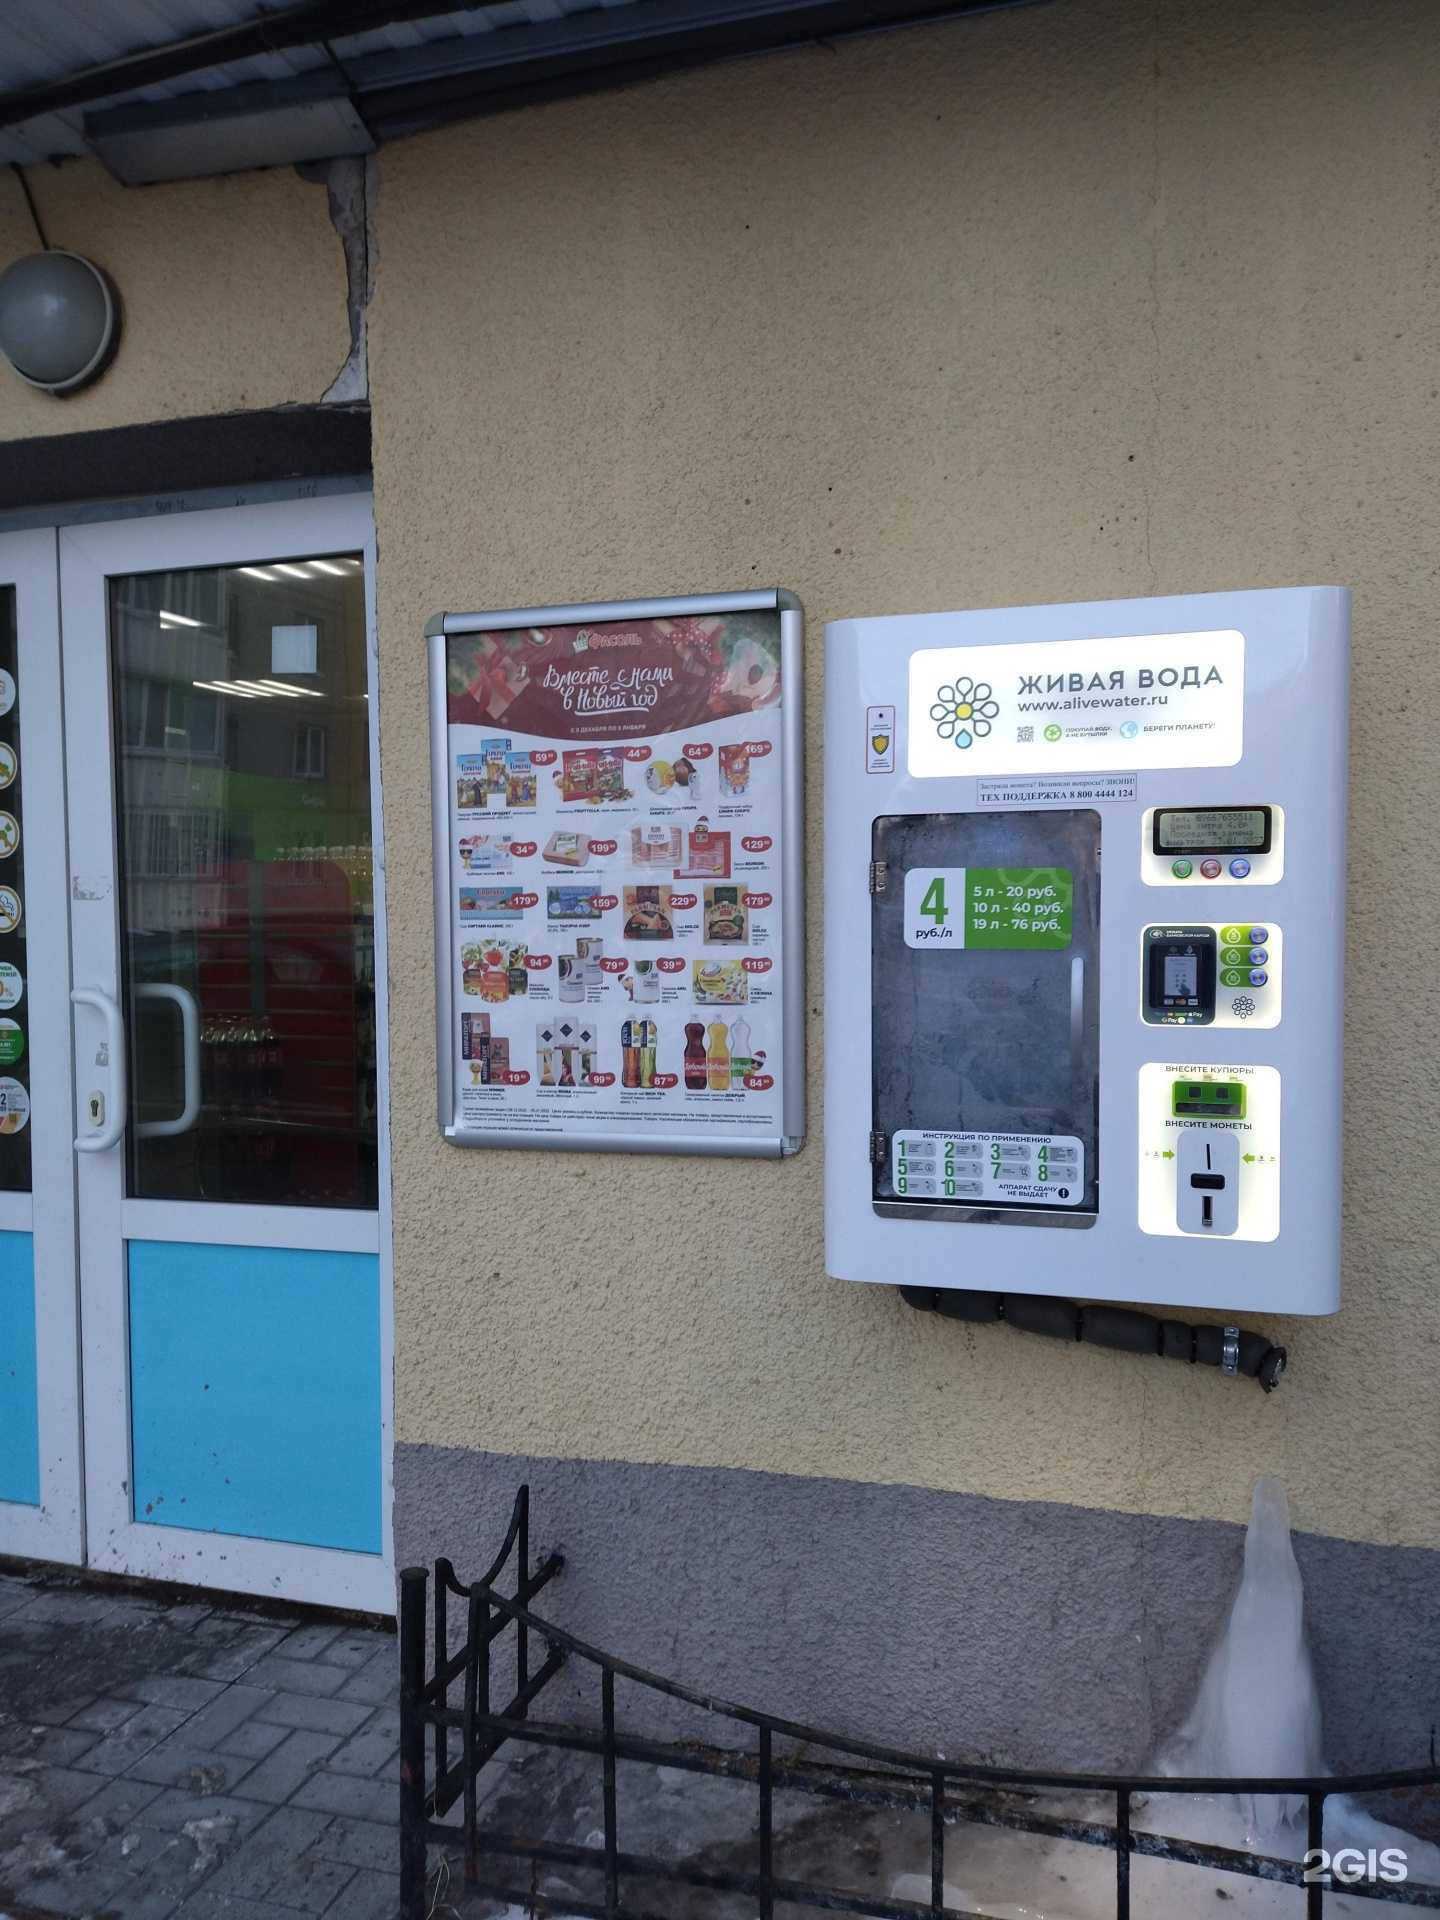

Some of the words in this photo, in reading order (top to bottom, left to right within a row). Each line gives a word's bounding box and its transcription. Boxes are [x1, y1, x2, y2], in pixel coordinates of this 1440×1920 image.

[543, 664, 609, 690] Вместе
[631, 667, 674, 690] нами
[1017, 670, 1125, 695] ЖИВАЯ
[1138, 665, 1224, 690] ВОДА
[560, 686, 575, 710] в
[577, 685, 626, 710] Новый
[631, 684, 658, 706] год
[1018, 695, 1169, 712] www.alivewater.ru
[1143, 724, 1174, 732] БЕРЕГИ
[1175, 722, 1216, 731] ПЛАНЕТУ!
[535, 754, 547, 762] 59
[980, 793, 1000, 802] ТЕХ
[1003, 791, 1067, 802] ПОДДЕРЖКА
[1069, 791, 1075, 799] 8
[1077, 790, 1093, 799] 800
[1095, 789, 1116, 798] 4444
[1118, 789, 1133, 797] 124
[516, 845, 528, 854] 34
[591, 844, 609, 852] 199
[745, 840, 763, 849] 129
[973, 886, 982, 897] 5
[985, 888, 994, 897] л
[1006, 886, 1023, 897] 20
[1027, 885, 1057, 900] руб.
[513, 896, 531, 905] 179
[920, 877, 949, 925] 4
[973, 902, 988, 913] 10
[991, 904, 1000, 913] л
[1012, 902, 1031, 913] 40
[1034, 901, 1064, 916] руб.
[973, 918, 986, 930] 19
[990, 920, 999, 930] л
[1011, 918, 1028, 930] 76
[1032, 918, 1061, 933] руб.
[916, 927, 953, 940] руб./л
[605, 961, 618, 969] 79
[663, 961, 675, 969] 39
[745, 961, 763, 969] 119
[508, 1073, 520, 1082] 19
[1165, 1065, 1208, 1073] ВНЕСИТЕ
[1210, 1066, 1254, 1075] КУПЮРЫ
[1165, 1120, 1208, 1129] ВНЕСИТЕ
[1210, 1121, 1253, 1130] МОНЕТЫ
[922, 1132, 976, 1141] ИНСТРУКЦИЯ
[992, 1135, 1052, 1144] ПРИМЕНЕНИЮ
[897, 1139, 906, 1157] 1
[944, 1141, 955, 1158] 2
[990, 1143, 1000, 1160] 3
[1037, 1145, 1049, 1163] 4
[898, 1158, 908, 1176] 5
[944, 1160, 955, 1177] 6
[990, 1162, 1001, 1179] 7
[1038, 1164, 1048, 1182] 8
[898, 1177, 908, 1194] 9
[942, 1179, 956, 1196] 10
[998, 1184, 1032, 1192] АППАРАТ
[1033, 1185, 1058, 1193] СДАЧУ
[1018, 1191, 1049, 1199] ВЫДАЕТ
